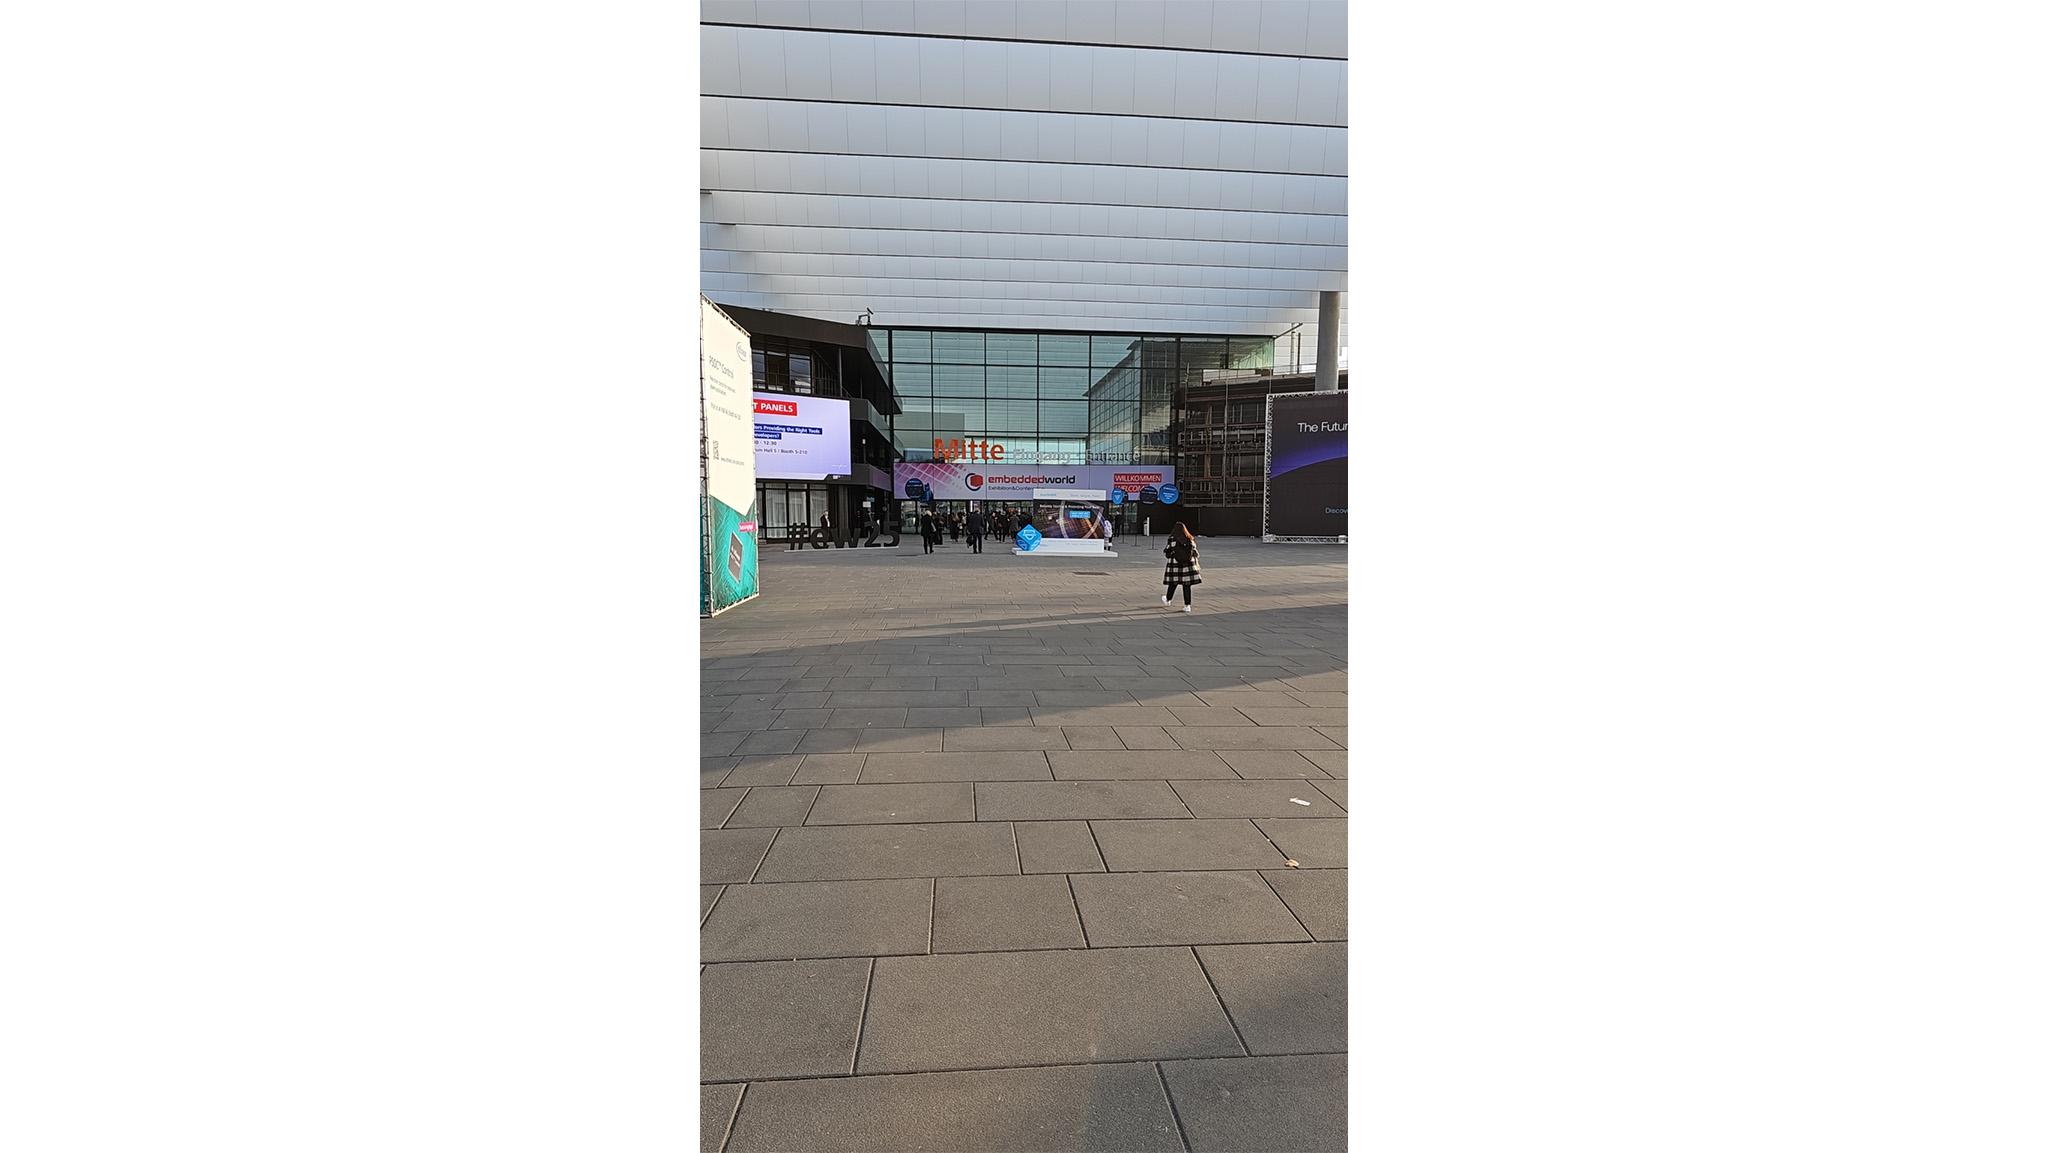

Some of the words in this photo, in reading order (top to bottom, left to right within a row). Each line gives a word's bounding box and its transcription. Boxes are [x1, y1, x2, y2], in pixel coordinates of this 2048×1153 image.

[760, 403, 794, 413] PANELS
[763, 425, 786, 433] Providing
[1297, 422, 1319, 432] The
[934, 438, 1005, 460] Mitte
[1012, 449, 1071, 464] Eingang
[1085, 449, 1141, 462] Entrance
[988, 474, 1076, 484] embeddedworld
[1114, 474, 1162, 482] WILLKOMMEN
[787, 521, 900, 550] #ew25
